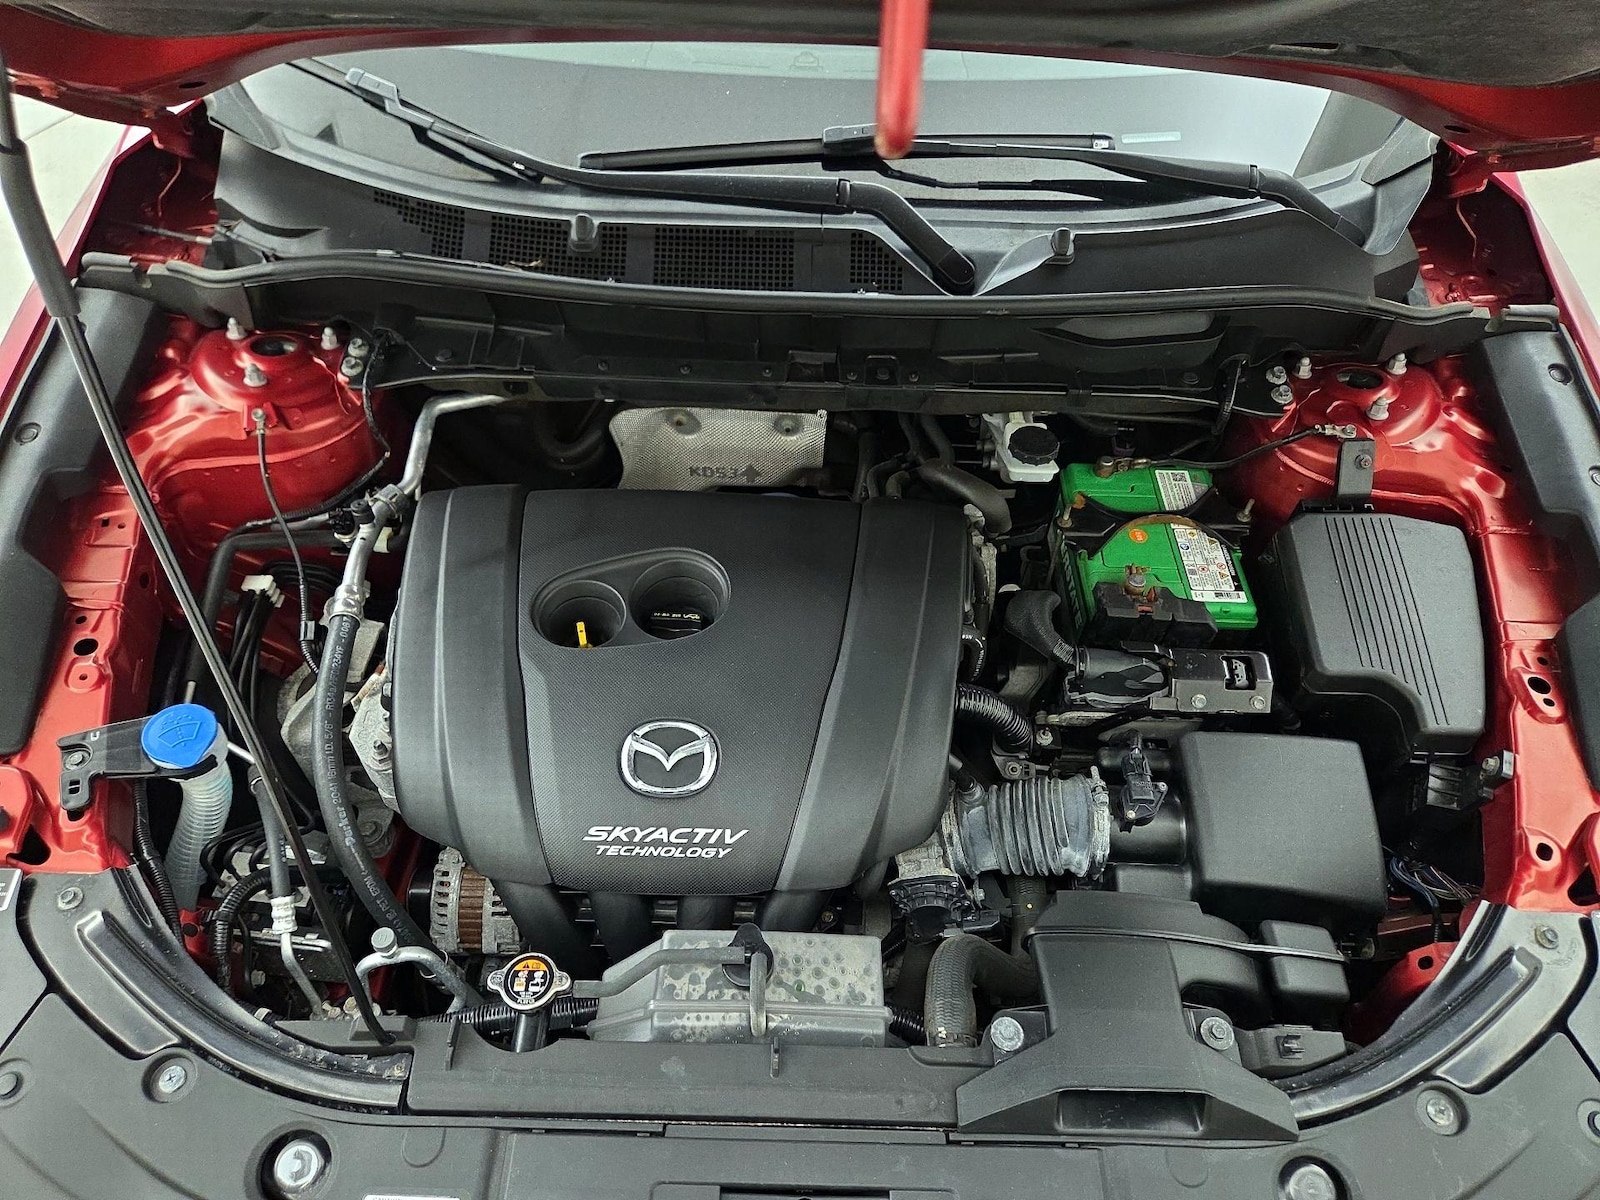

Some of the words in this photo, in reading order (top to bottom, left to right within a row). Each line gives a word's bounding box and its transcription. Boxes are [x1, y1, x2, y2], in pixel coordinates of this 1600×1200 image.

[327, 756, 337, 779] 16mm
[329, 782, 342, 805] 2041
[337, 805, 356, 847] Parker
[582, 826, 750, 844] SKYACTIV
[595, 845, 733, 858] TECHNOLOGY
